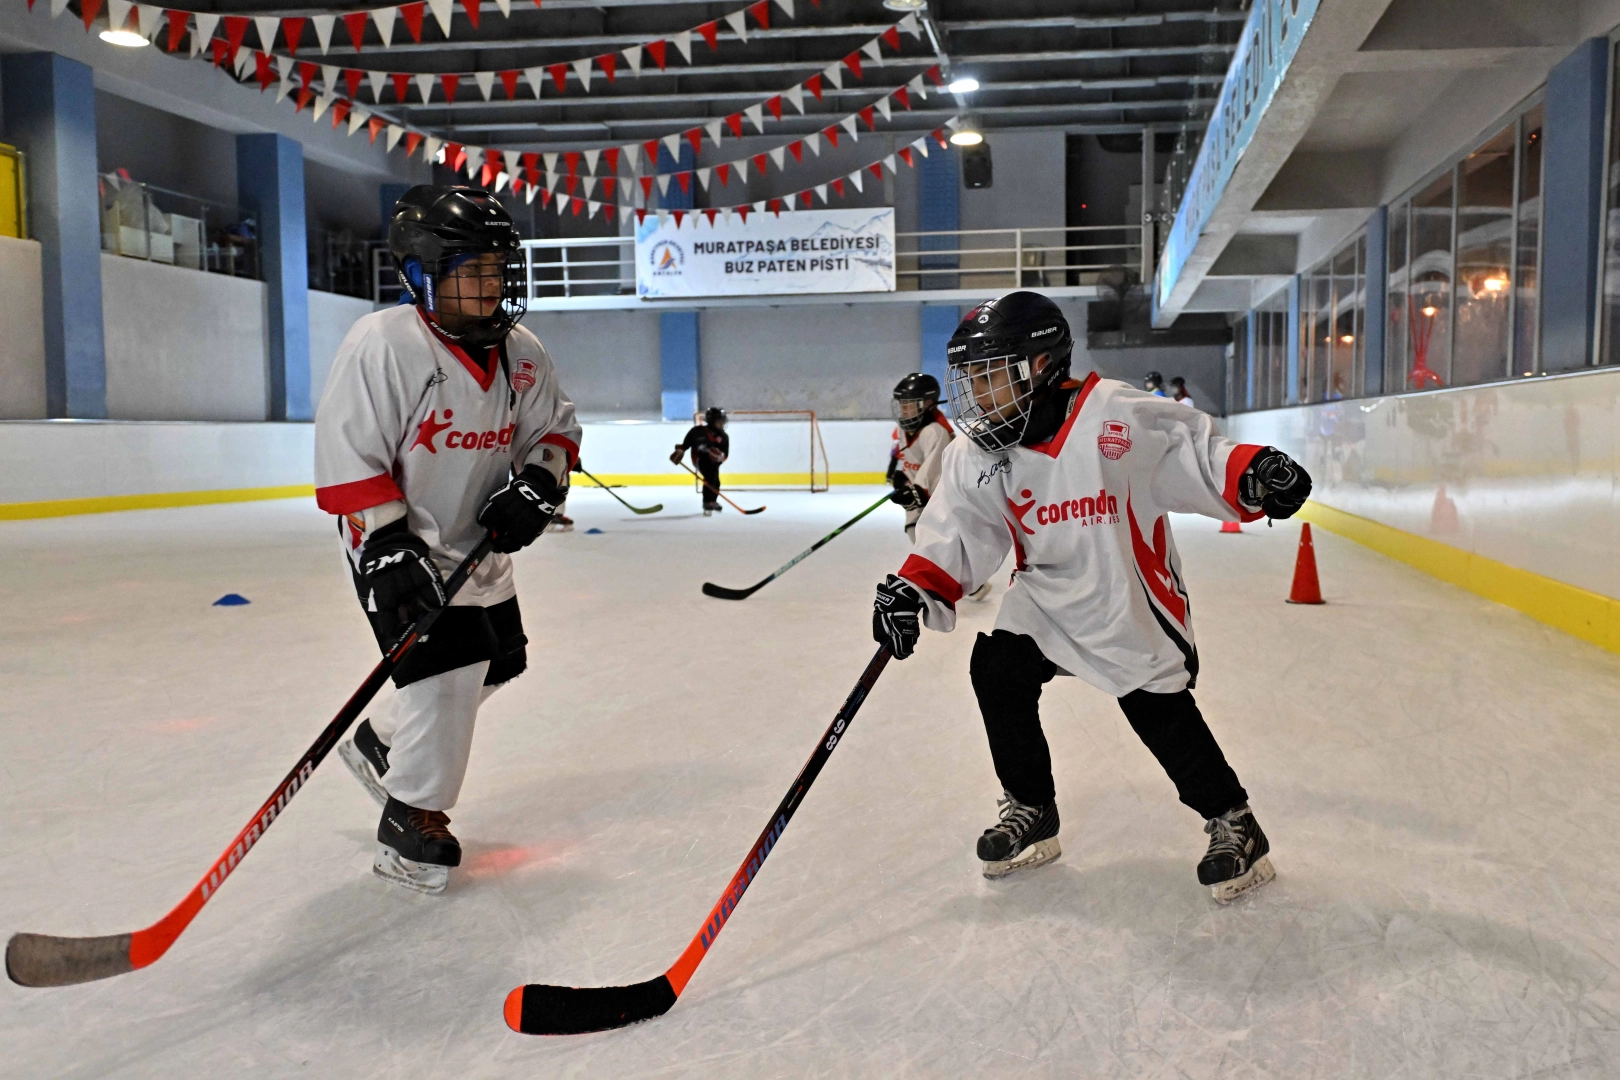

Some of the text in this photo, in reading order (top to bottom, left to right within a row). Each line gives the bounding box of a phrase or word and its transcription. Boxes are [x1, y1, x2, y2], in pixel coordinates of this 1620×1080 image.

[694, 240, 787, 255] MURATPAŞA
[791, 233, 880, 251] BELEDİYESİ
[725, 256, 849, 274] BUZ PATEN PİSTİ
[425, 276, 434, 311] BAUER
[1031, 326, 1058, 338] BAUER
[518, 484, 557, 516] CC
[201, 759, 315, 901] WARRIOR
[387, 816, 405, 833] EASTON
[700, 813, 787, 950] WARRIOR
